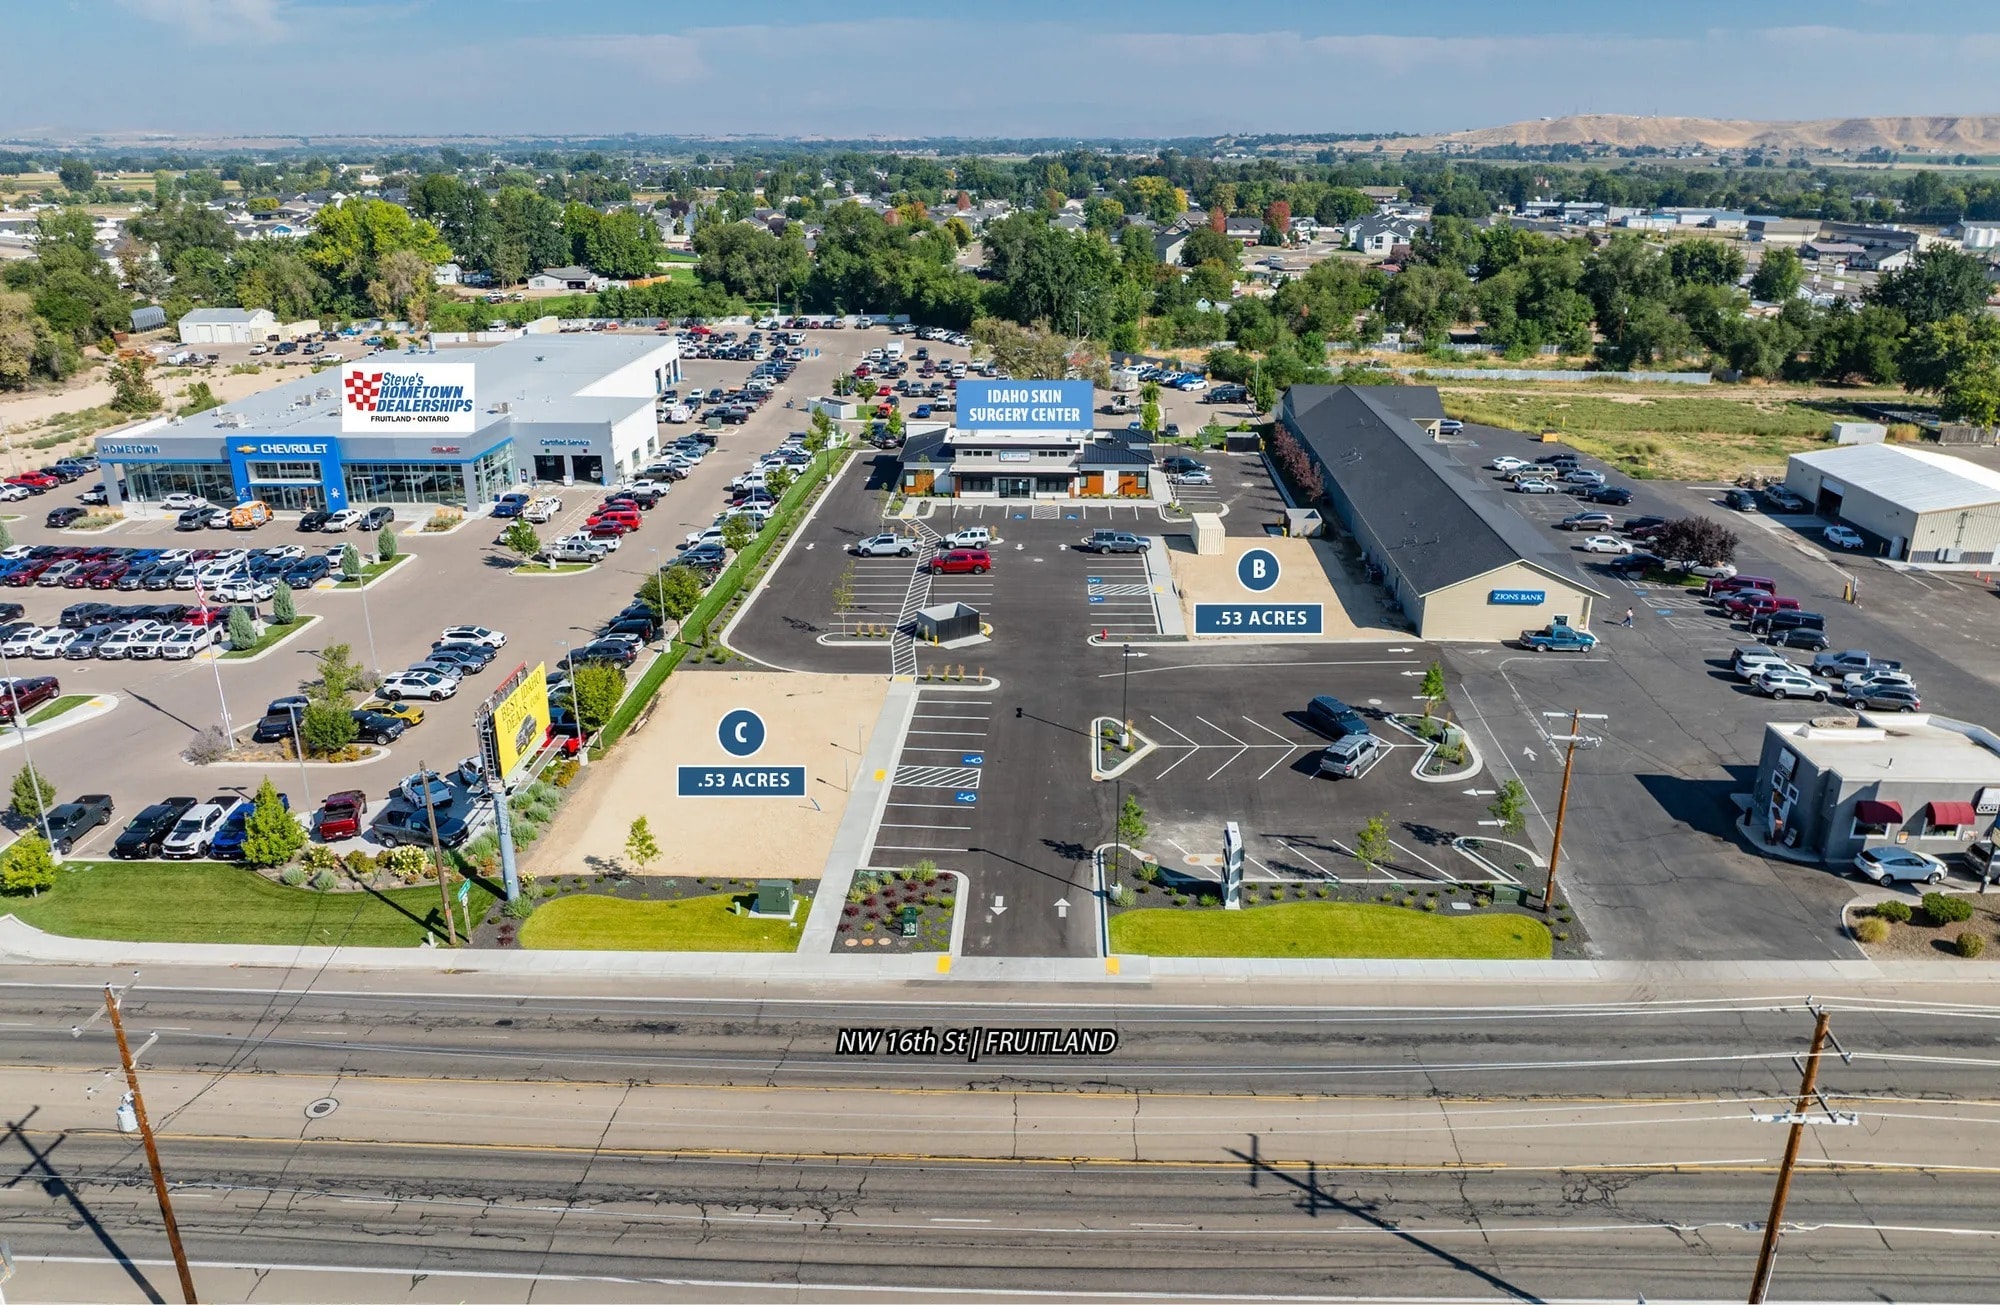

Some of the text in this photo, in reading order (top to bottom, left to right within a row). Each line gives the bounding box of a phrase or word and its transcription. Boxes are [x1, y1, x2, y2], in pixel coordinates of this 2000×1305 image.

[102, 444, 160, 454] HOMETOWN
[260, 443, 328, 454] CHEVROLET
[1520, 593, 1543, 601] BANK
[501, 692, 518, 721] BEST
